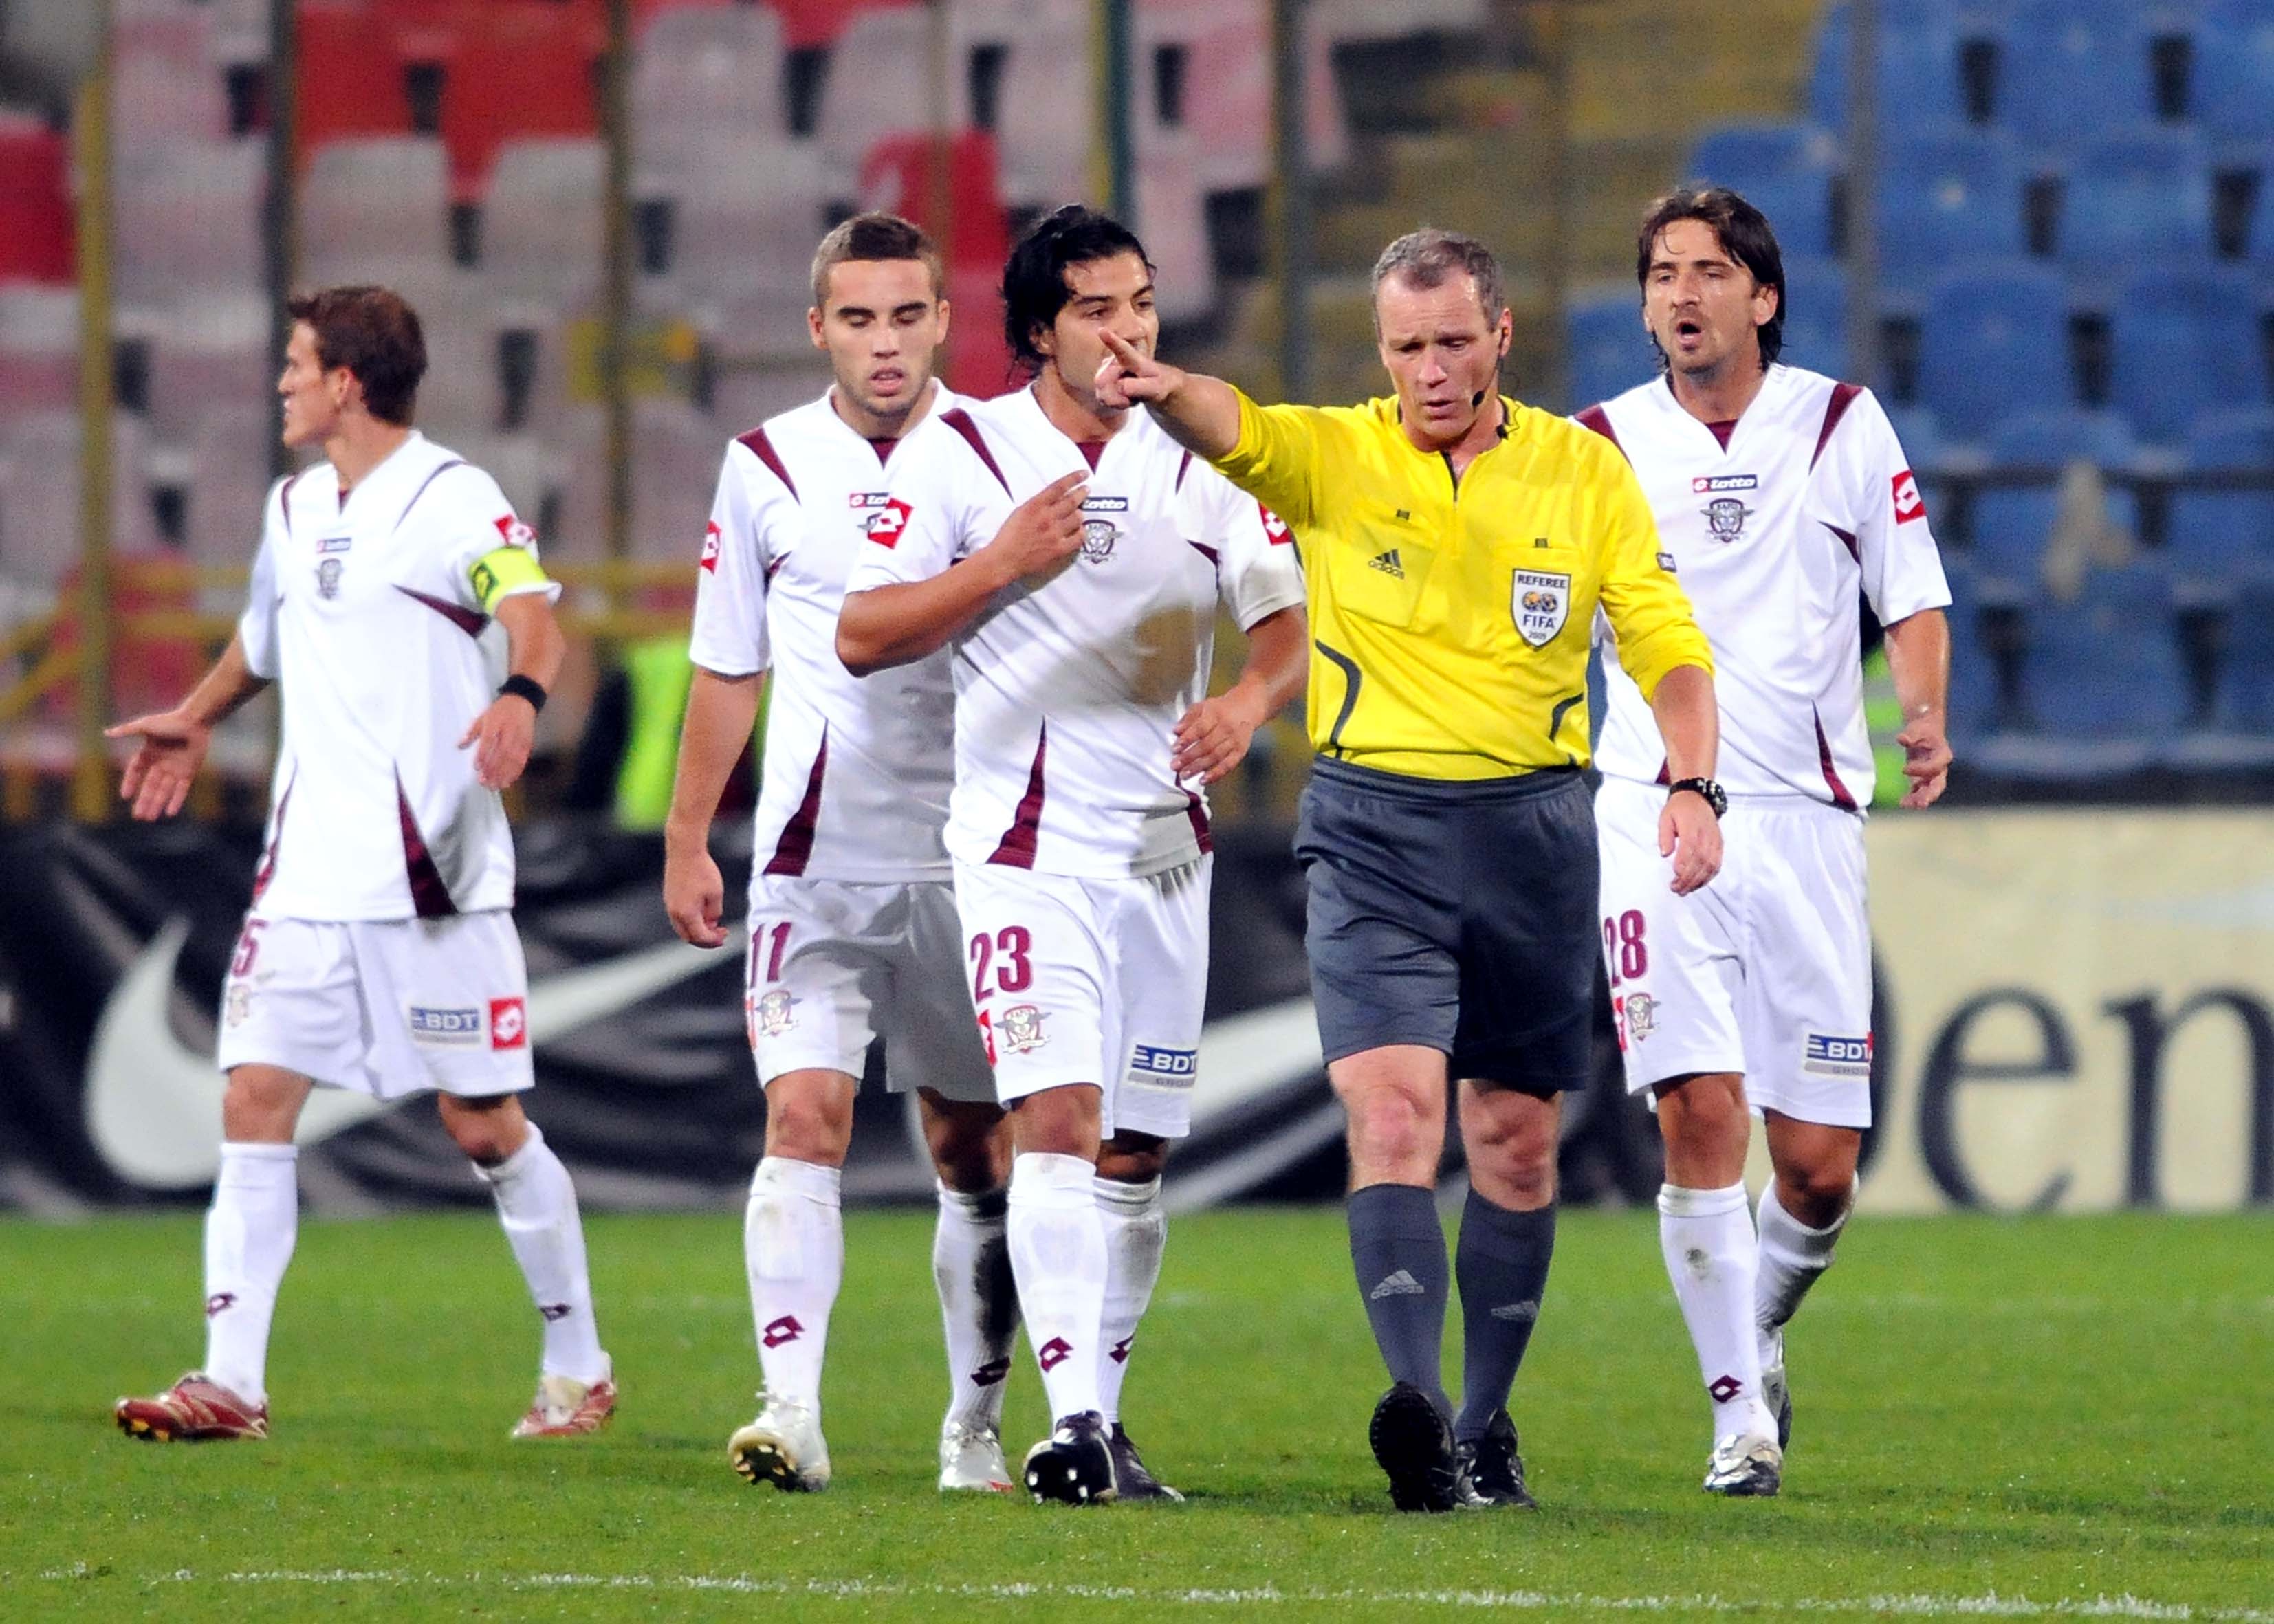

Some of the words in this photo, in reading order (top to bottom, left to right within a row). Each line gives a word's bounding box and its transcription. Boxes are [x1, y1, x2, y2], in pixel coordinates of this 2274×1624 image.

[1518, 574, 1566, 589] REFEREE
[1522, 614, 1556, 629] FIFA
[750, 922, 792, 989] 11
[970, 925, 1033, 1005] 23
[1604, 909, 1647, 988] 28
[426, 1013, 477, 1030] BDT
[1152, 1053, 1196, 1073] BDT
[1858, 942, 2274, 1214] en
